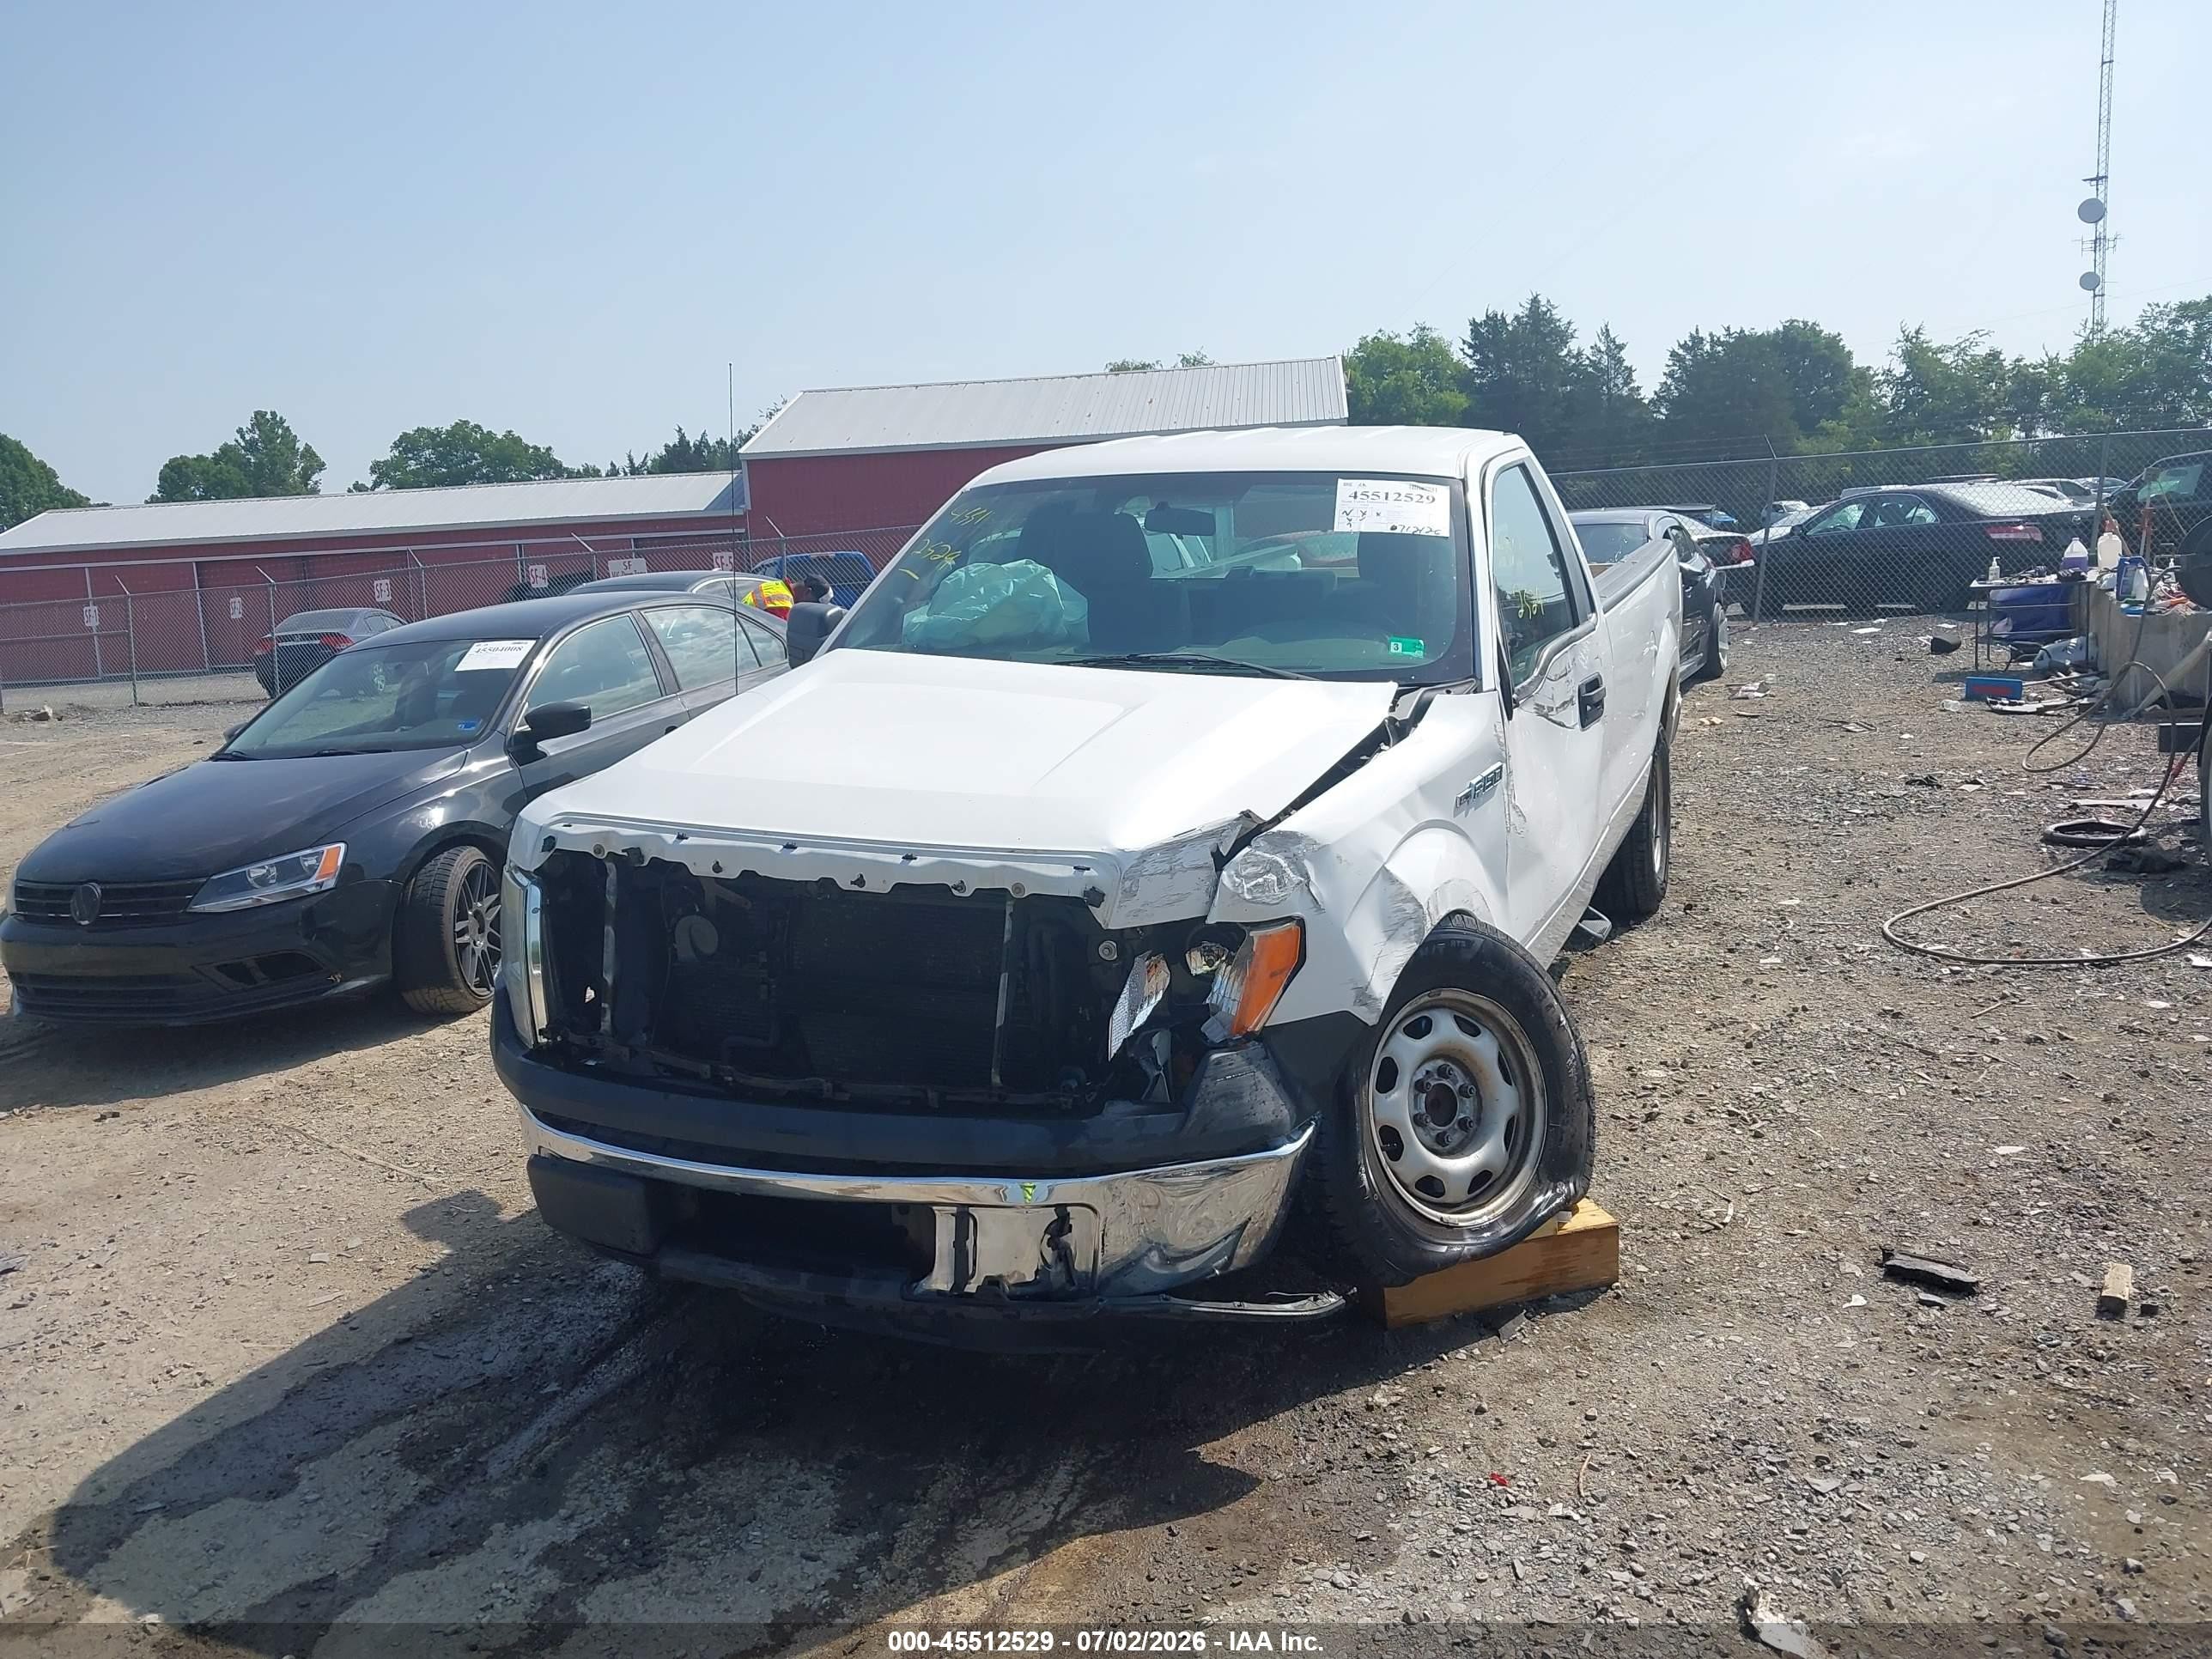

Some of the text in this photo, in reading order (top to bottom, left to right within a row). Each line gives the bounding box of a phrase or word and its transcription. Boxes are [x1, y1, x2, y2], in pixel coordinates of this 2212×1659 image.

[1349, 490, 1436, 504] 45512529
[623, 560, 633, 571] SF
[715, 556, 733, 572] SF-5
[530, 568, 547, 585] SF-4
[1393, 642, 1400, 651] 3
